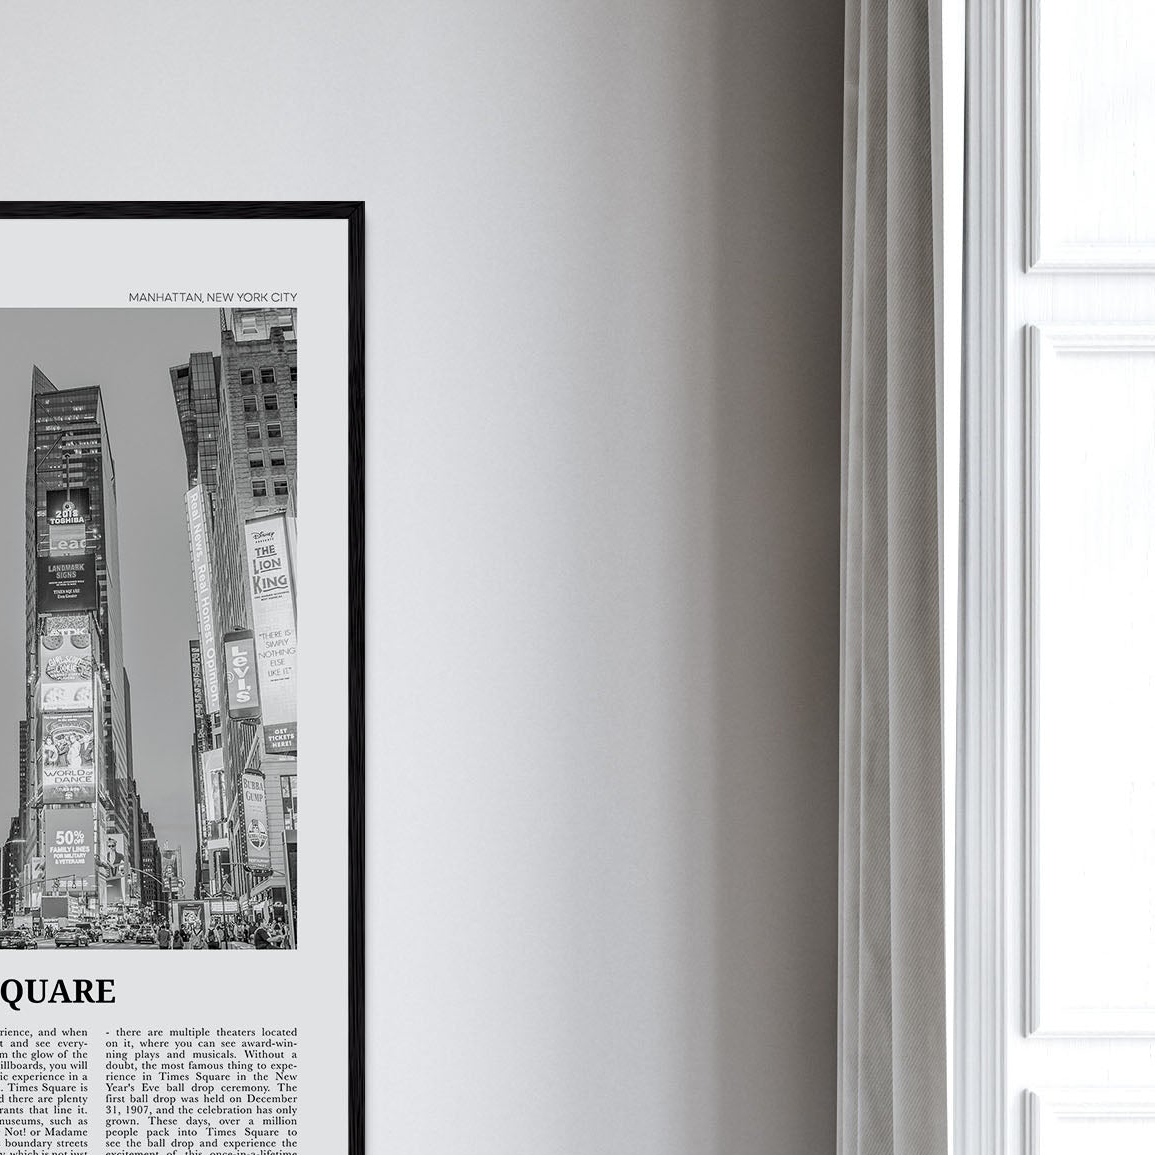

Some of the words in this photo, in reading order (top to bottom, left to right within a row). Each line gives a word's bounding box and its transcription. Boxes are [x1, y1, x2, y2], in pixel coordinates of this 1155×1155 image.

[129, 293, 204, 303] MANHATTAN,
[207, 293, 234, 302] NEW
[237, 293, 268, 302] YORK
[271, 292, 297, 302] CITY
[191, 493, 201, 520] Real
[255, 544, 276, 556] THE
[48, 563, 85, 572] LANDMARK
[253, 558, 281, 574] LION
[55, 571, 77, 579] SIGNS
[198, 564, 208, 593] Real
[252, 575, 288, 595] KING
[201, 596, 213, 644] Honest
[265, 639, 289, 649] SIMPLY
[258, 647, 297, 658] NOTHING
[270, 658, 285, 667] ELSE
[267, 668, 281, 677] LIKE
[268, 734, 295, 742] TICKETS
[55, 776, 93, 784] DANCE
[243, 778, 264, 792] BUBBA
[245, 790, 263, 802] GUMP
[38, 1028, 57, 1036] and
[61, 1028, 88, 1036] when
[106, 1050, 128, 1061] ning
[135, 1050, 160, 1061] plays
[167, 1050, 185, 1059] and
[193, 1050, 237, 1059] musicals.
[244, 1050, 284, 1059] Without
[8, 1095, 34, 1103] there
[57, 1095, 88, 1105] plenty
[105, 1106, 121, 1116] 31,
[126, 1106, 153, 1116] 1907,
[156, 1106, 174, 1114] and
[178, 1106, 194, 1114] the
[197, 1106, 252, 1114] celebration
[256, 1106, 273, 1114] has
[276, 1106, 297, 1116] only
